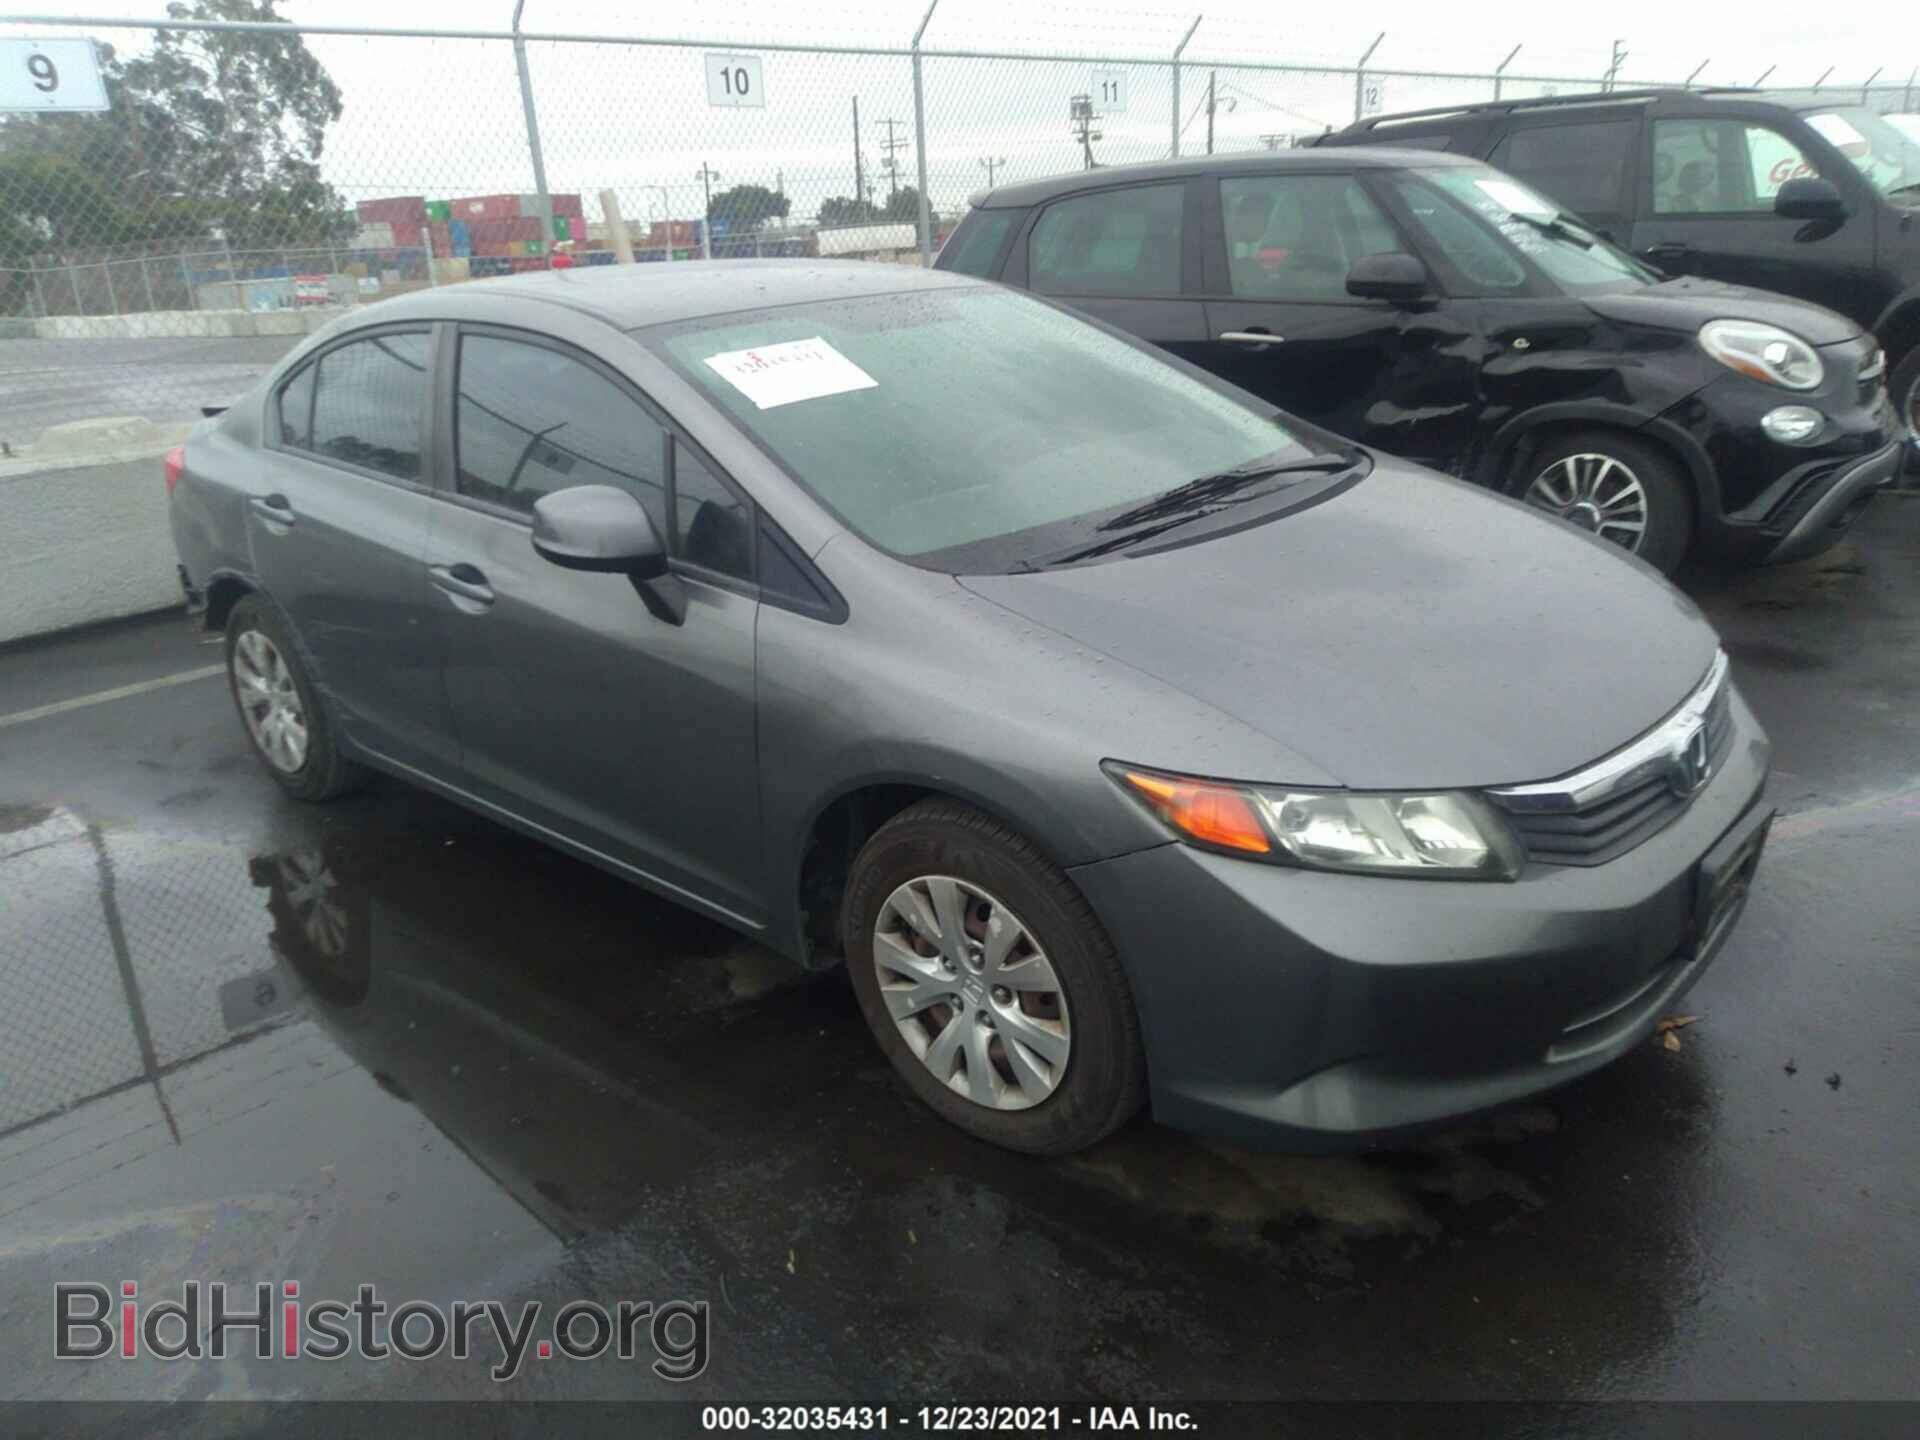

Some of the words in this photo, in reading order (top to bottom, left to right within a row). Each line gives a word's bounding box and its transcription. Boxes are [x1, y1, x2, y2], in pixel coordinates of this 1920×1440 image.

[27, 53, 59, 93] 9
[720, 66, 749, 95] 10
[1101, 80, 1118, 102] 11
[1366, 87, 1377, 105] 12
[1768, 158, 1812, 184] Ge
